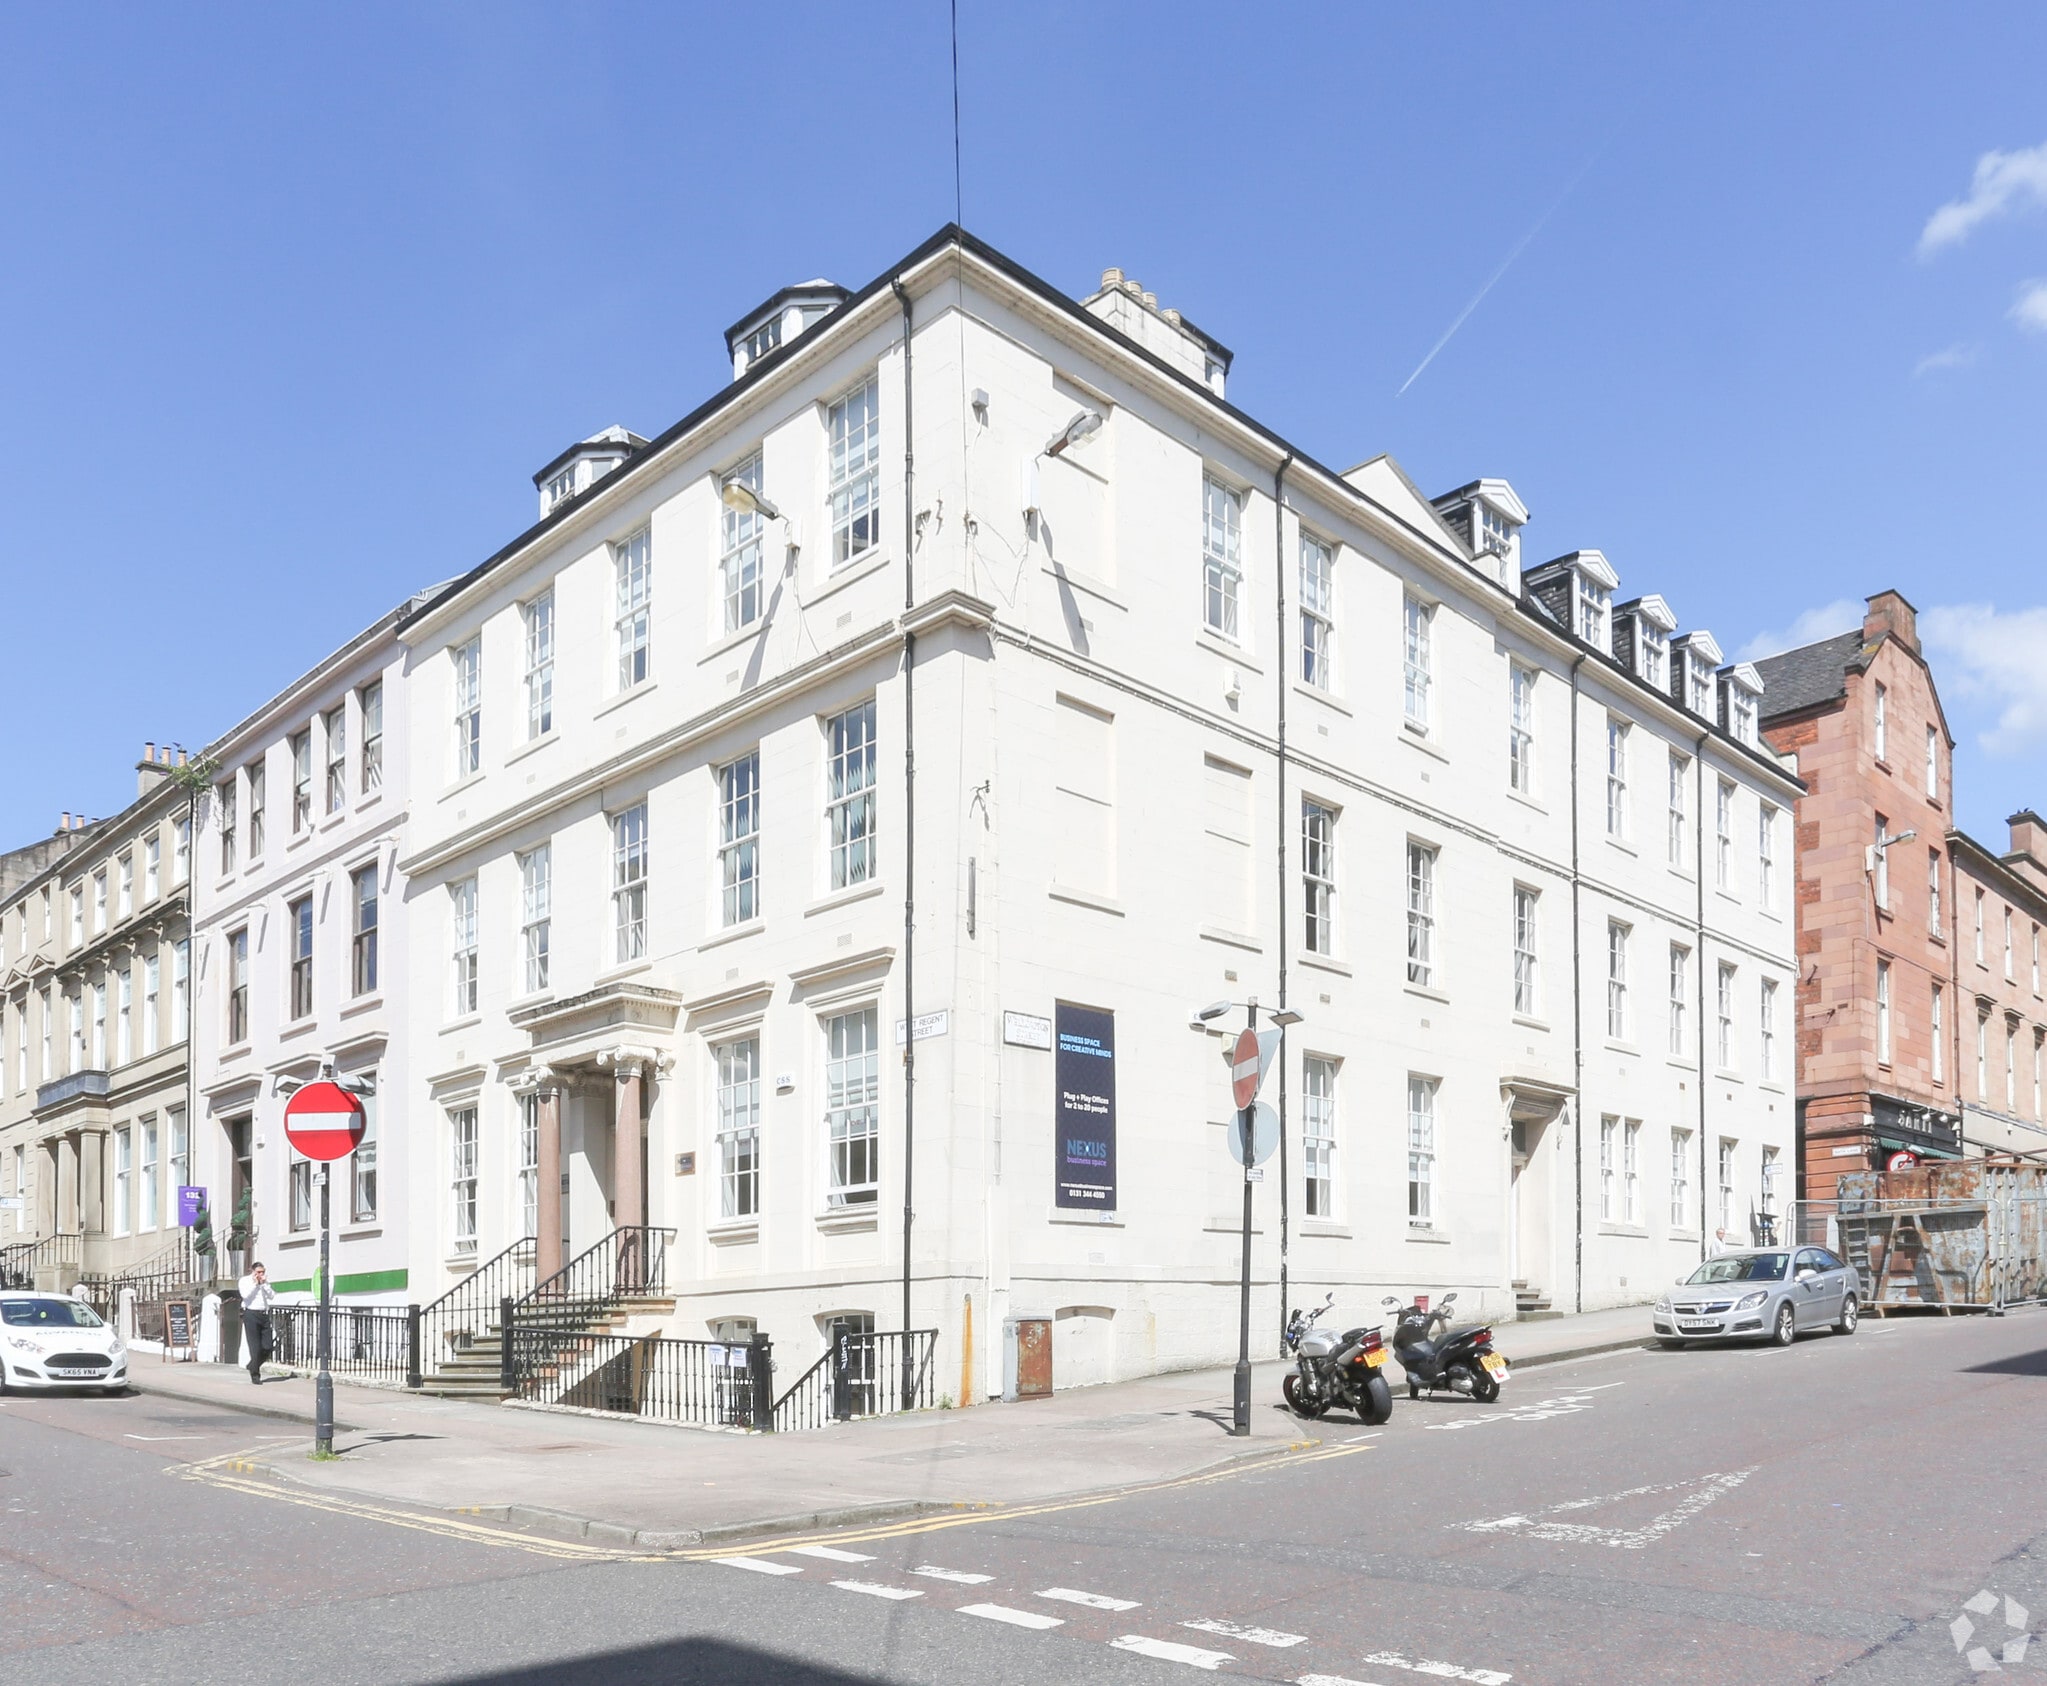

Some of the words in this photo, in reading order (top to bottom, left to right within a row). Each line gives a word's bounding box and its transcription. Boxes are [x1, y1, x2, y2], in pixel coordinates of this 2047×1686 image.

[919, 1013, 944, 1027] REGENT
[912, 1025, 933, 1037] TREET
[1060, 1033, 1084, 1044] BUSINESS
[1084, 1038, 1101, 1047] SPACE
[1060, 1042, 1071, 1051] FOR
[1071, 1045, 1095, 1055] CREATIVE
[1063, 1091, 1076, 1101] Plug
[1080, 1093, 1091, 1103] Play
[1091, 1095, 1109, 1104] Offices
[1064, 1101, 1073, 1109] for
[1091, 1105, 1108, 1113] people
[1066, 1140, 1107, 1158] NEXUS
[1067, 1155, 1091, 1165] business
[1091, 1159, 1107, 1167] space
[1494, 1369, 1505, 1379] L
